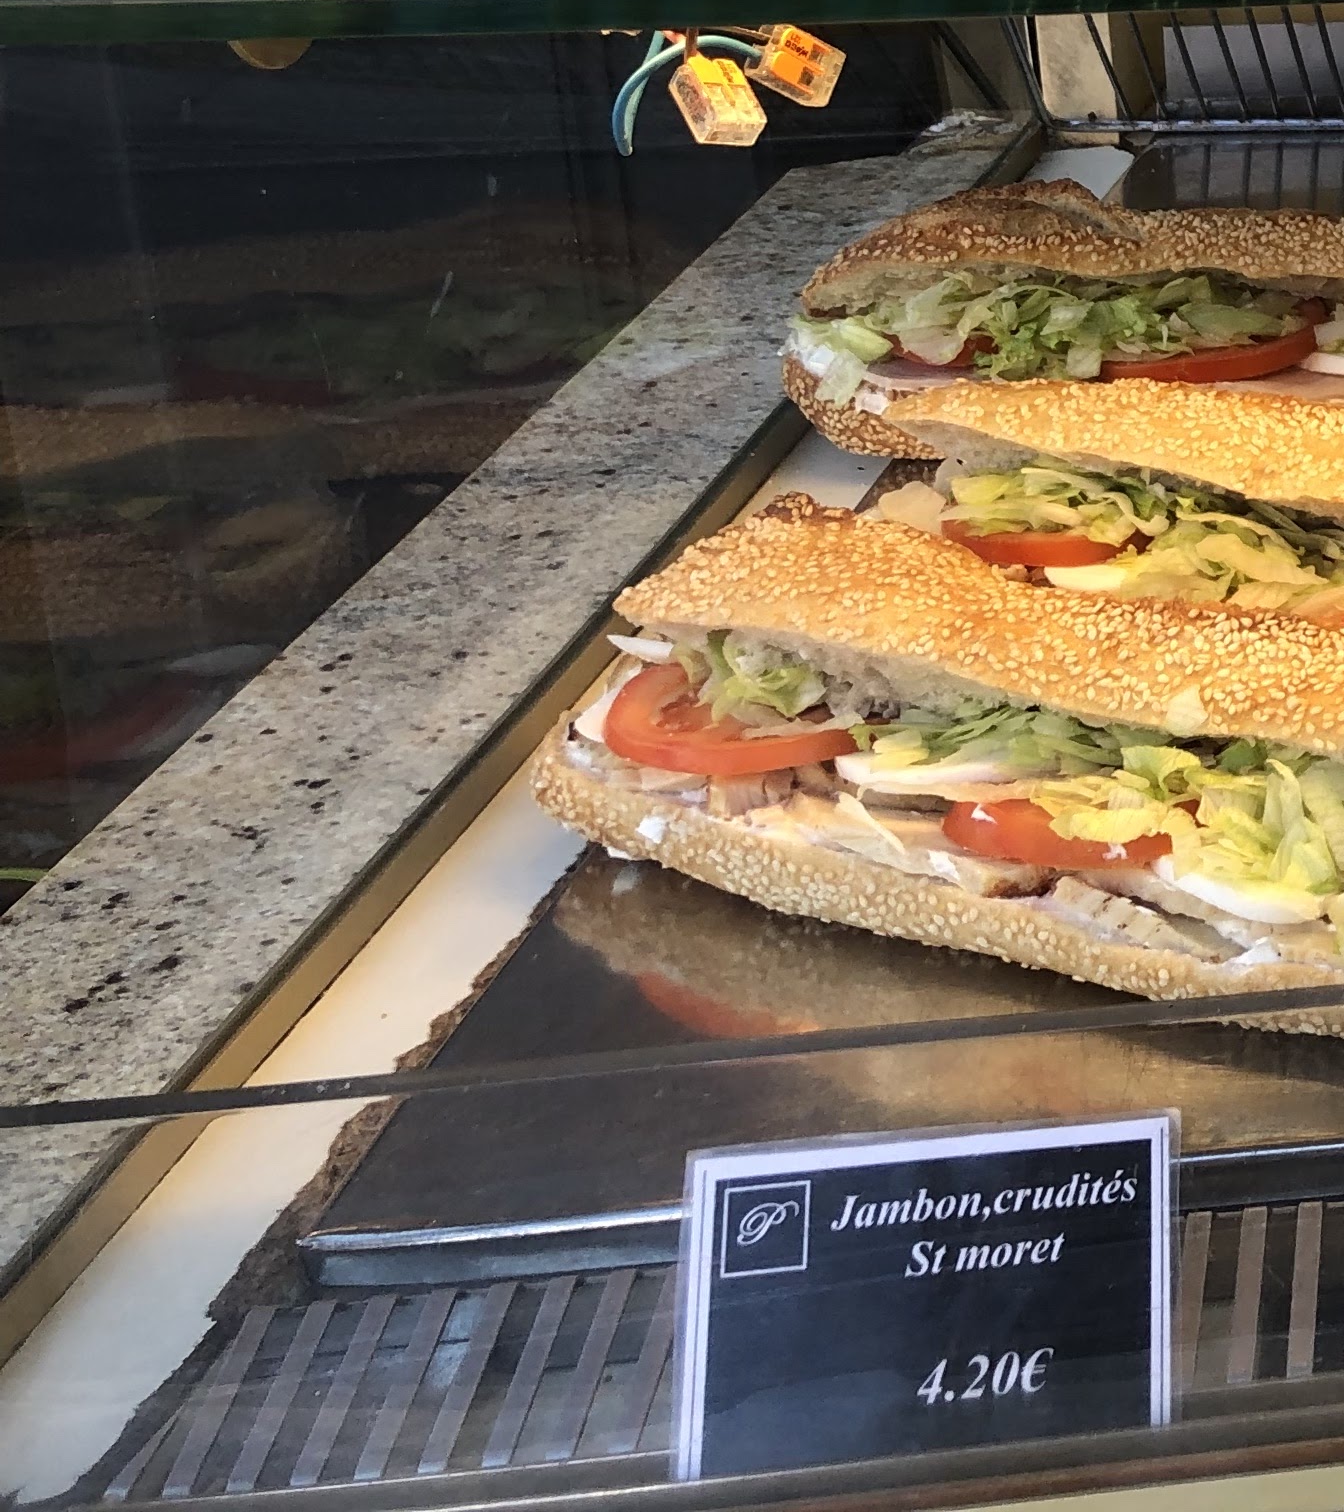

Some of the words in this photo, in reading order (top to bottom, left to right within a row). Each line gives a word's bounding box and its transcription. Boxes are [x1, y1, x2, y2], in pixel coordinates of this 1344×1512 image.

[830, 1168, 1139, 1232] Jambon,crudités
[904, 1240, 944, 1278] St
[955, 1230, 1066, 1273] moret
[916, 1346, 1055, 1406] 4.20€
